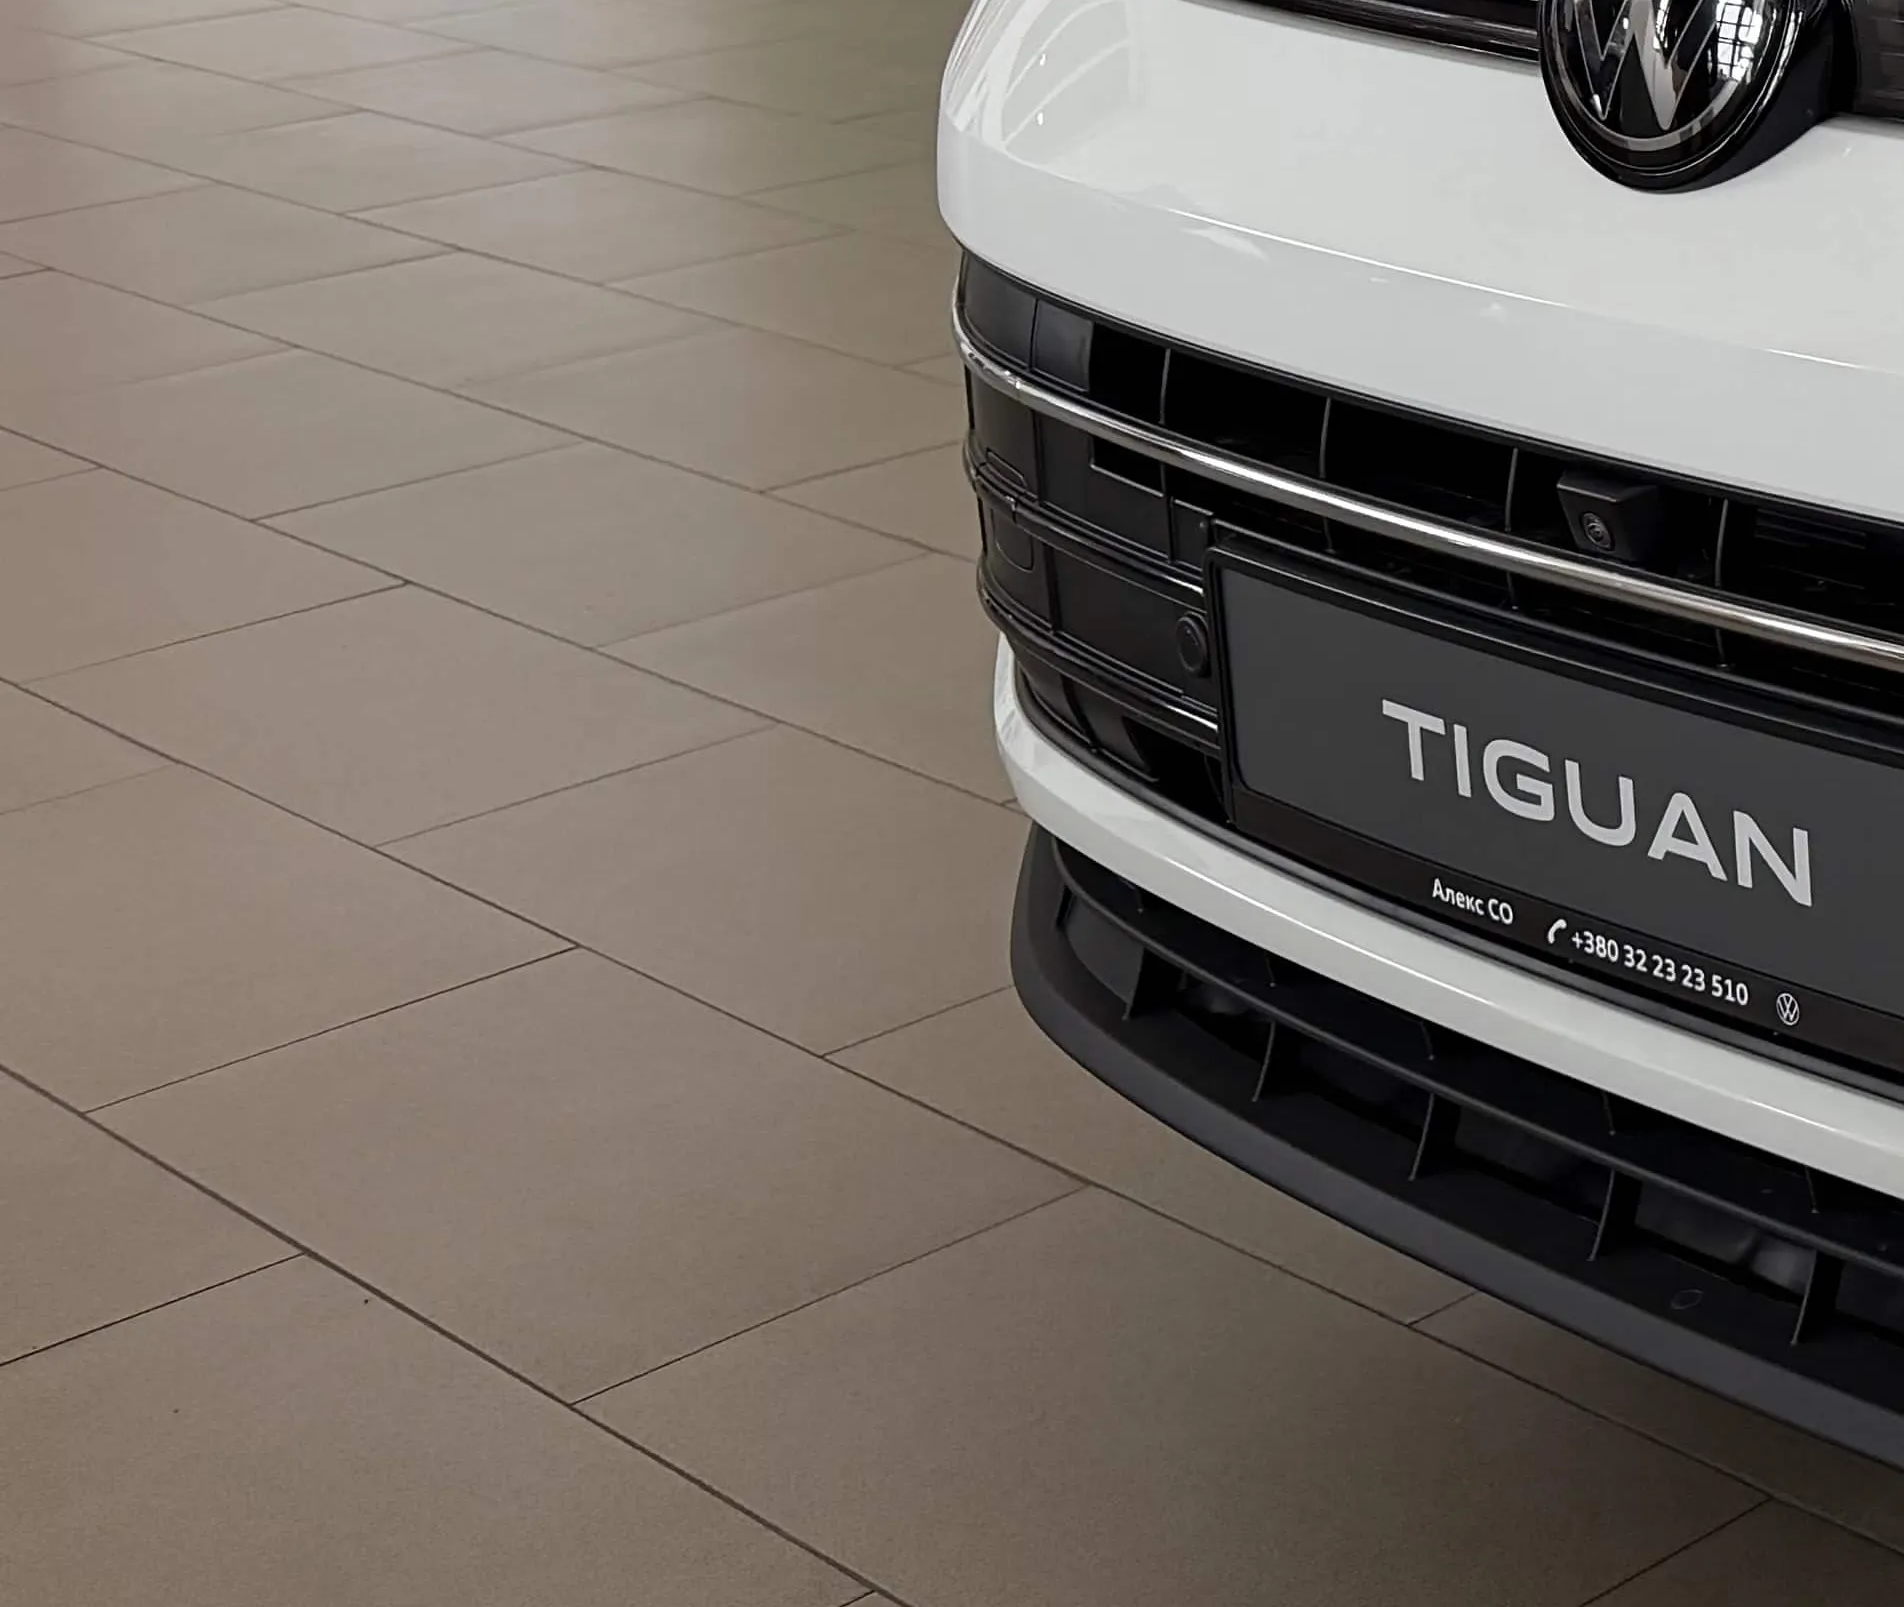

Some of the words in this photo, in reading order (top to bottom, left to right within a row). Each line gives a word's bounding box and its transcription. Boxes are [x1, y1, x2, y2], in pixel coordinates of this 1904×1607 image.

[1382, 698, 1814, 907] TIGUAN
[1432, 878, 1484, 916] Алекс
[1488, 898, 1514, 925] СО
[1571, 930, 1619, 963] +380
[1623, 944, 1648, 973] 32
[1652, 954, 1677, 982] 23
[1681, 964, 1706, 992] 23
[1711, 975, 1749, 1006] 510
